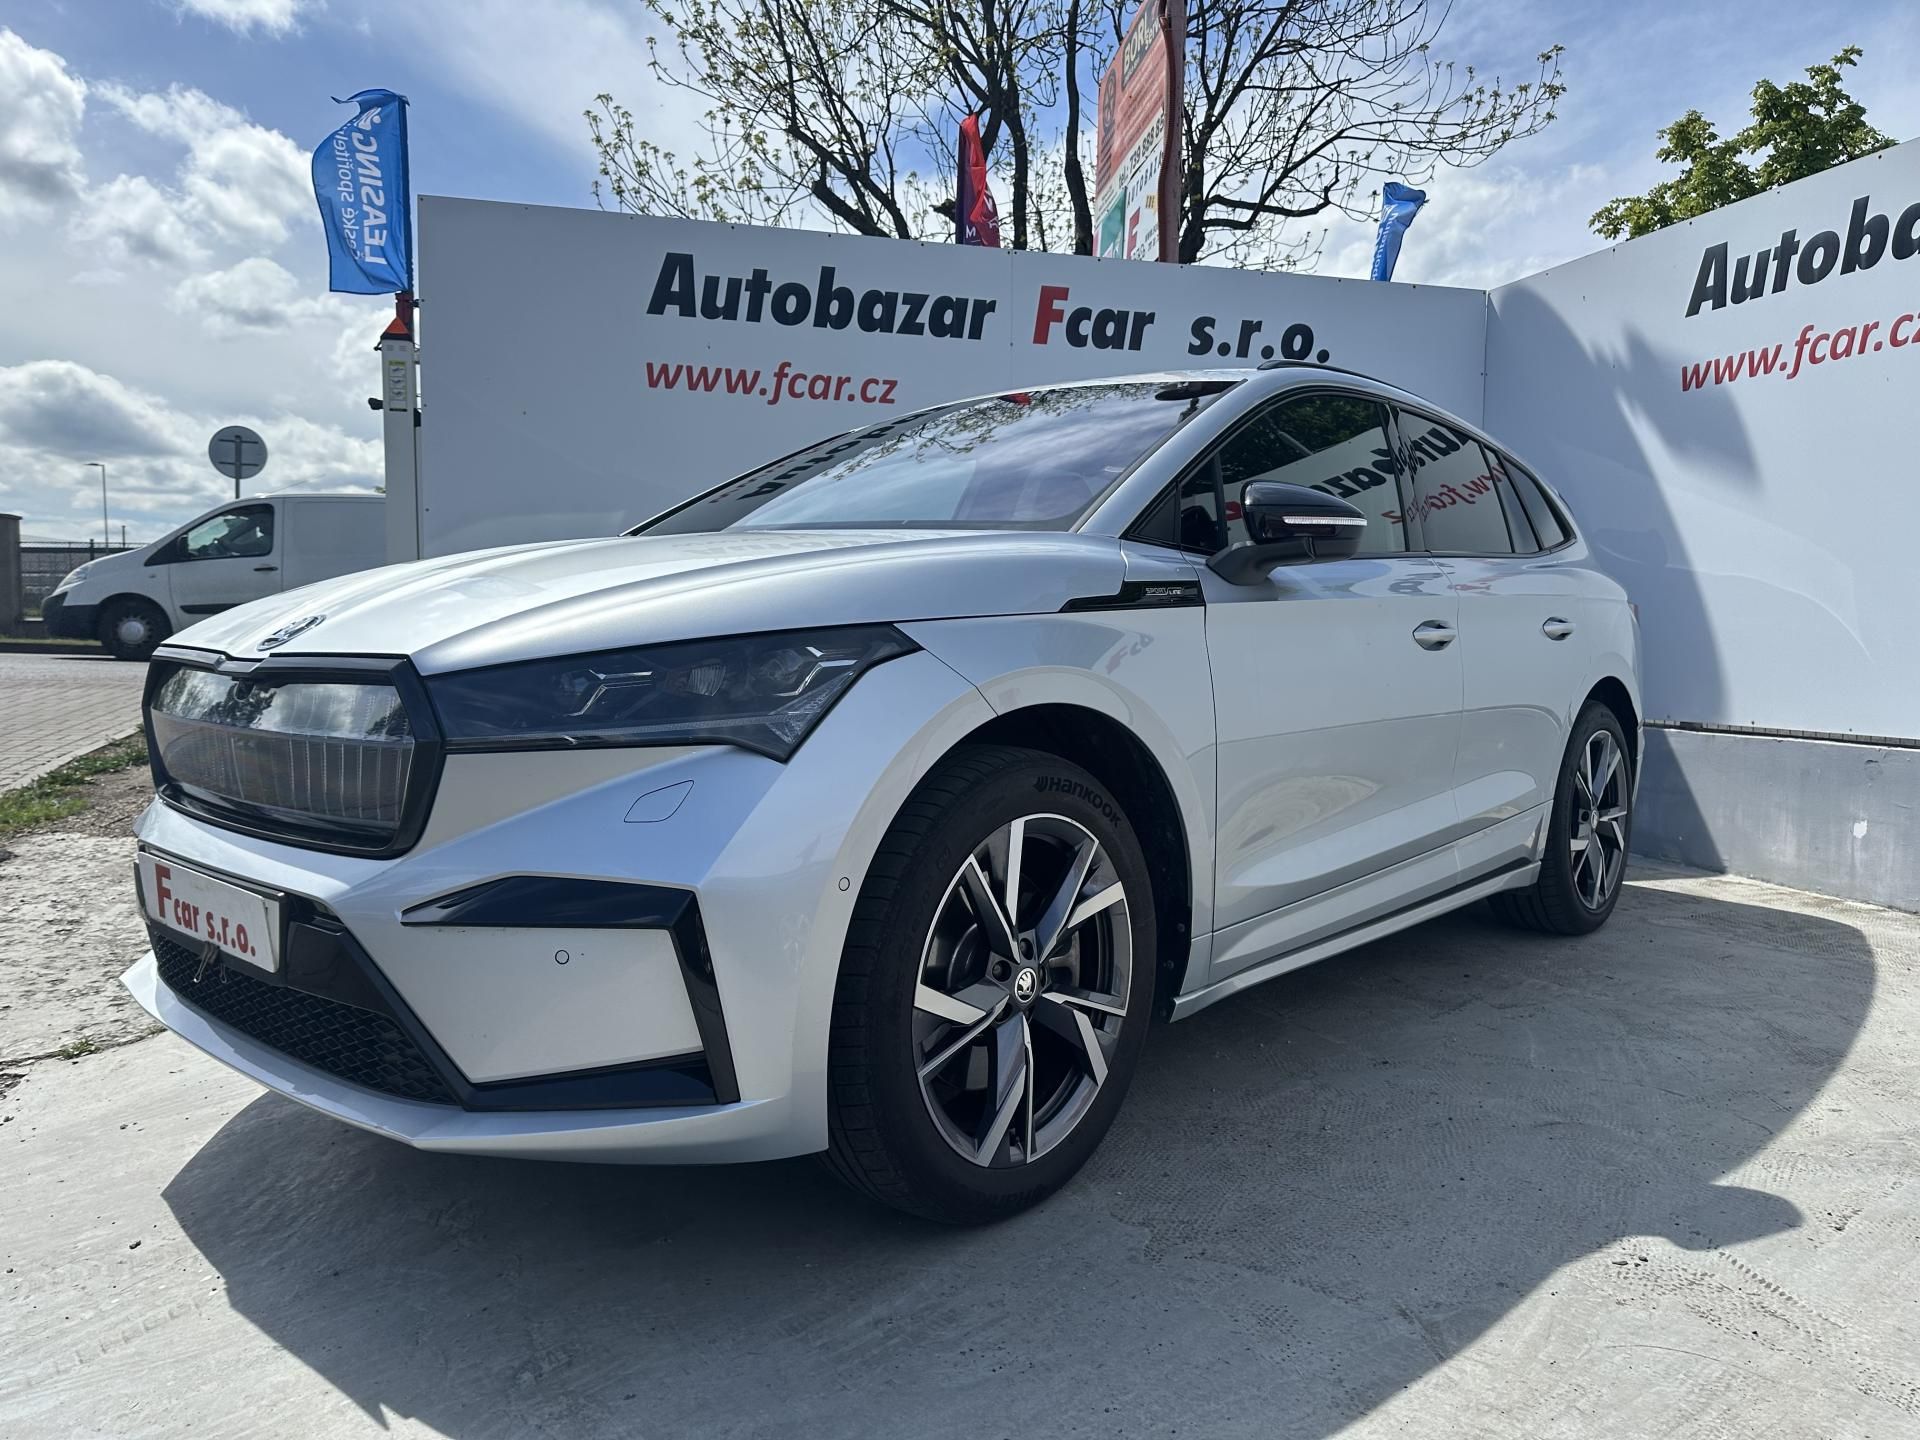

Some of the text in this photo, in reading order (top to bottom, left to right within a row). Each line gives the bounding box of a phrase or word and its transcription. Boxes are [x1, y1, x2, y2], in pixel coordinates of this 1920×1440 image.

[646, 252, 1330, 364] Autobazar Fcar s.r.o.
[646, 361, 899, 405] www.fcar.cz
[155, 863, 256, 957] Fcar s.r.o.
